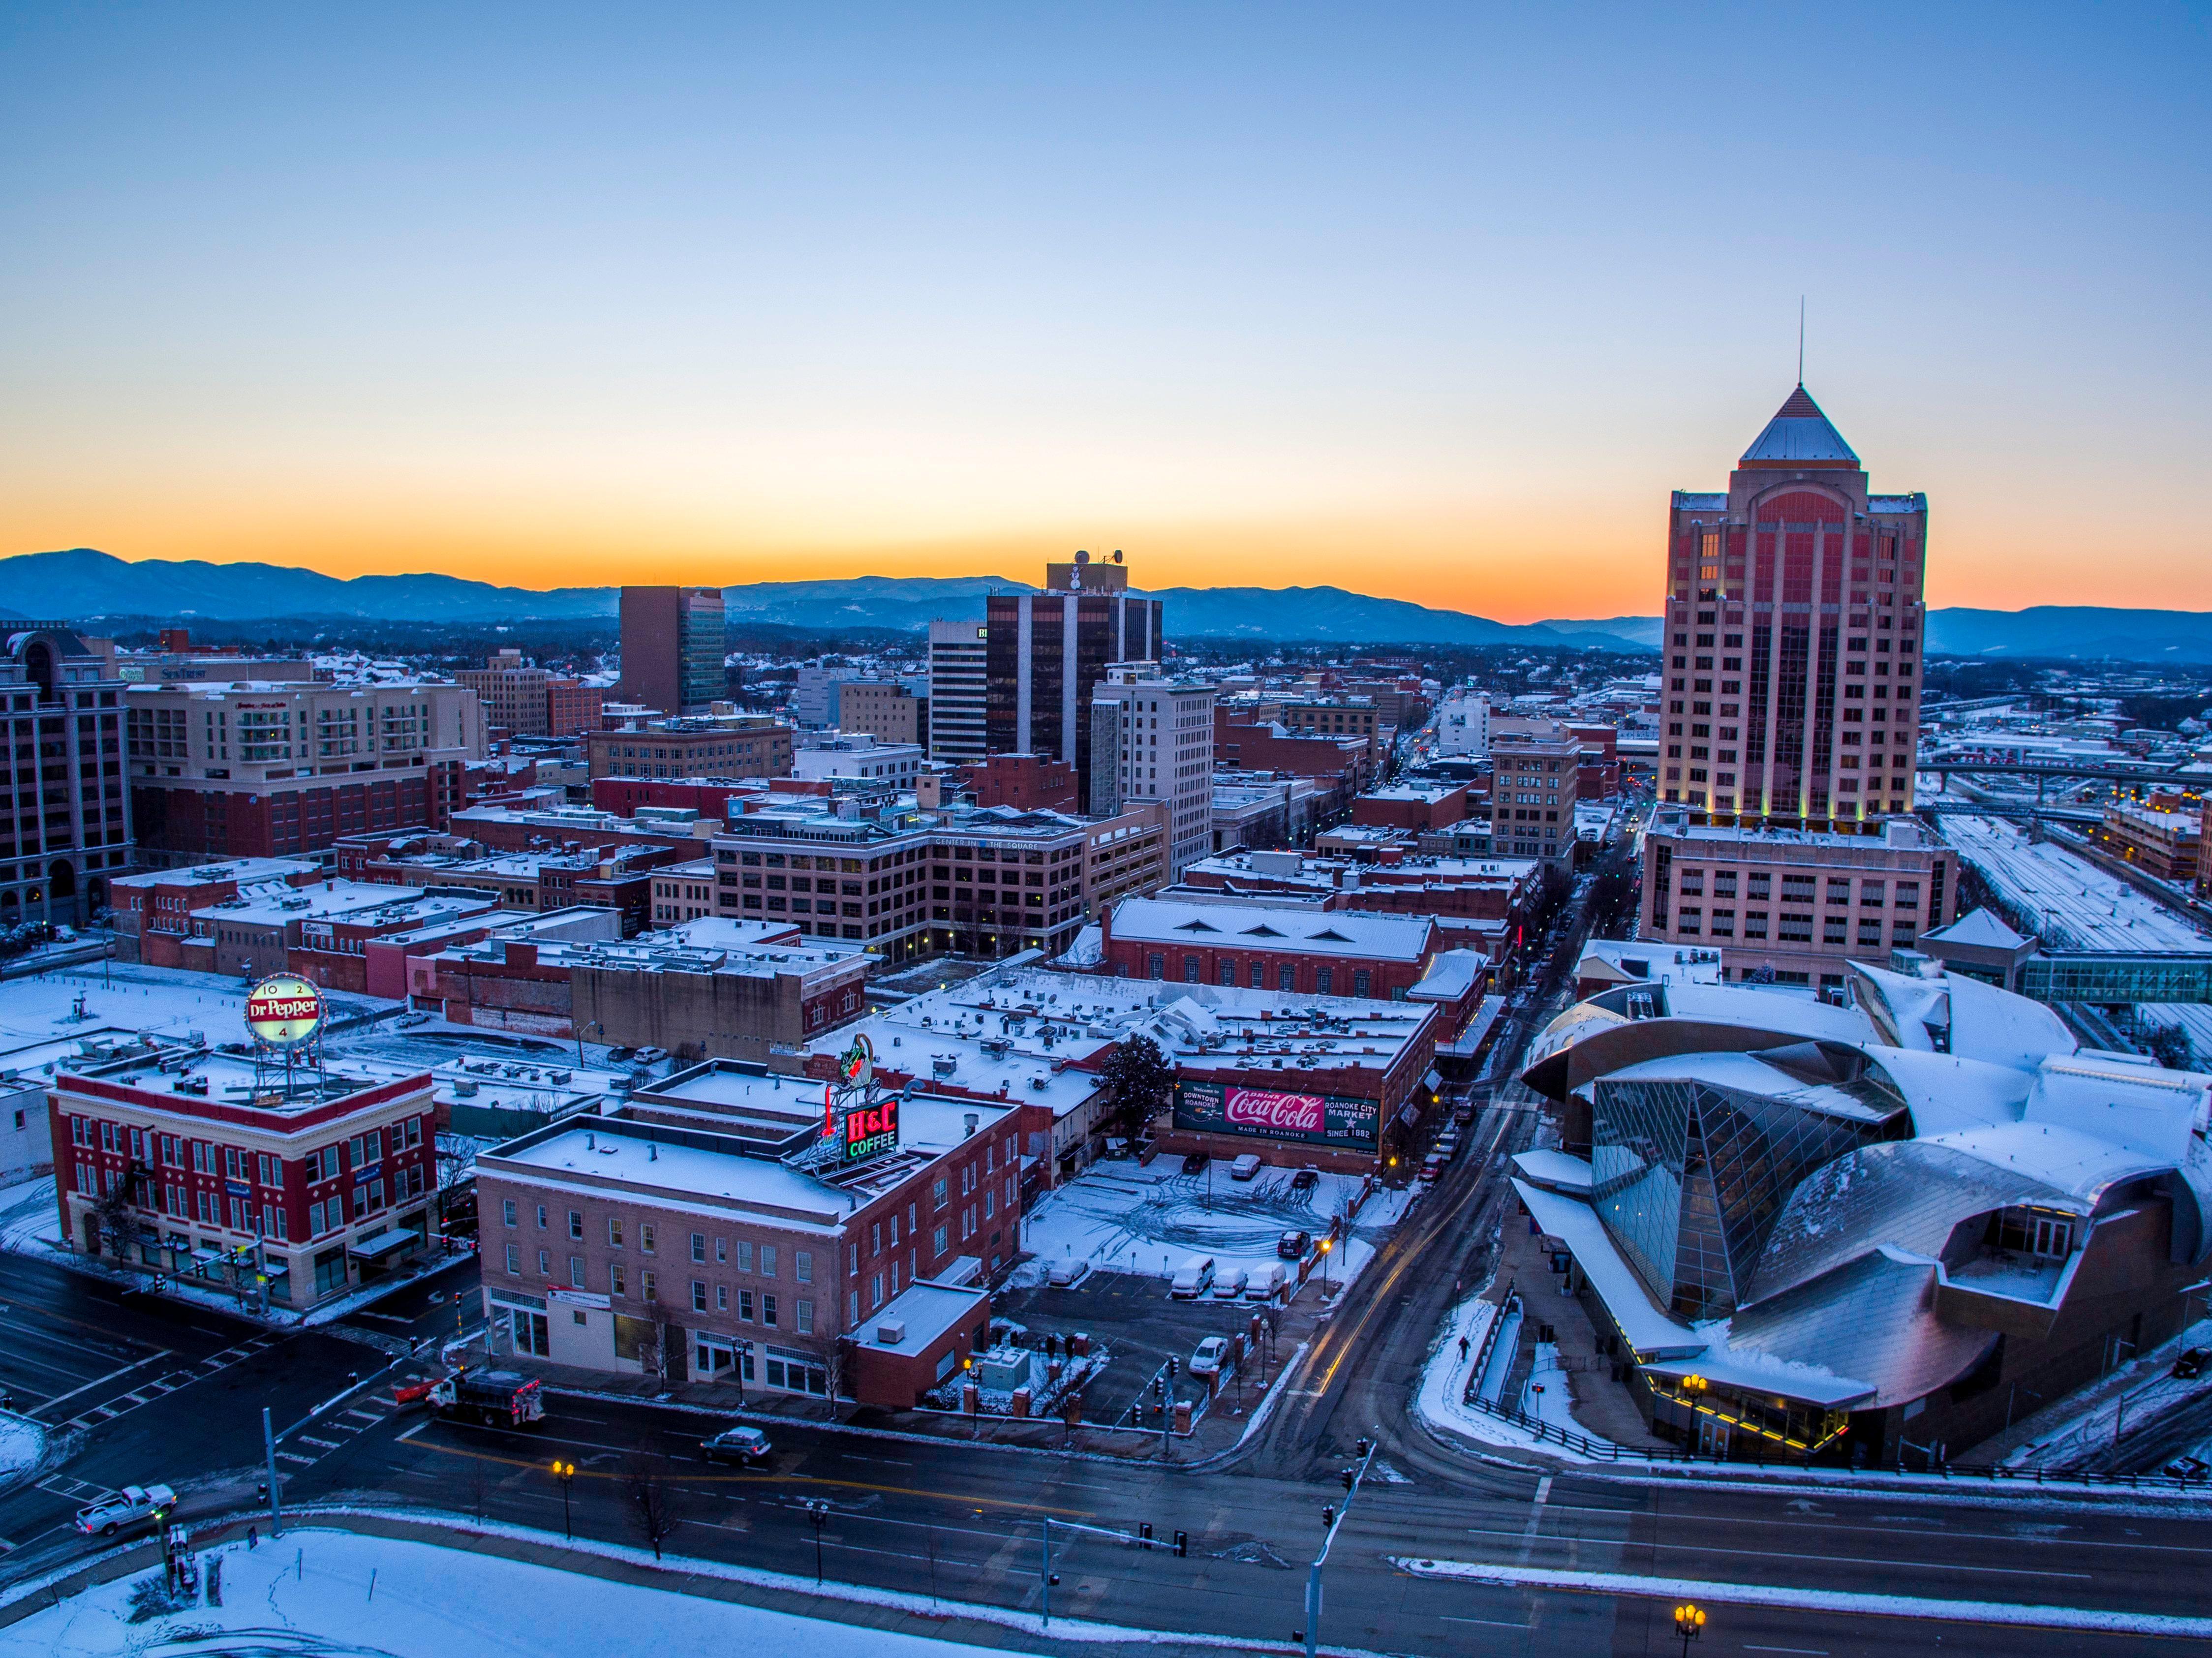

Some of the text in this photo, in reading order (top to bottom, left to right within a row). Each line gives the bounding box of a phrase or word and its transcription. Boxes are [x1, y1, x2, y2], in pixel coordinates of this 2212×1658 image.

[264, 986, 277, 995] 10
[250, 1000, 317, 1019] Dr Pepper
[279, 1028, 287, 1037] 4
[1184, 1092, 1219, 1104] DOWNTOWN
[1185, 1099, 1216, 1108] ROANOKE
[1227, 1090, 1322, 1129] Coca-Cola
[1325, 1102, 1377, 1114] ROANOKE CITY
[1328, 1109, 1372, 1120] MARKET
[848, 1102, 895, 1142] H&C
[1269, 1130, 1306, 1138] ROANOKE
[1352, 1129, 1370, 1139] 1882
[850, 1131, 894, 1156] COFFEE
